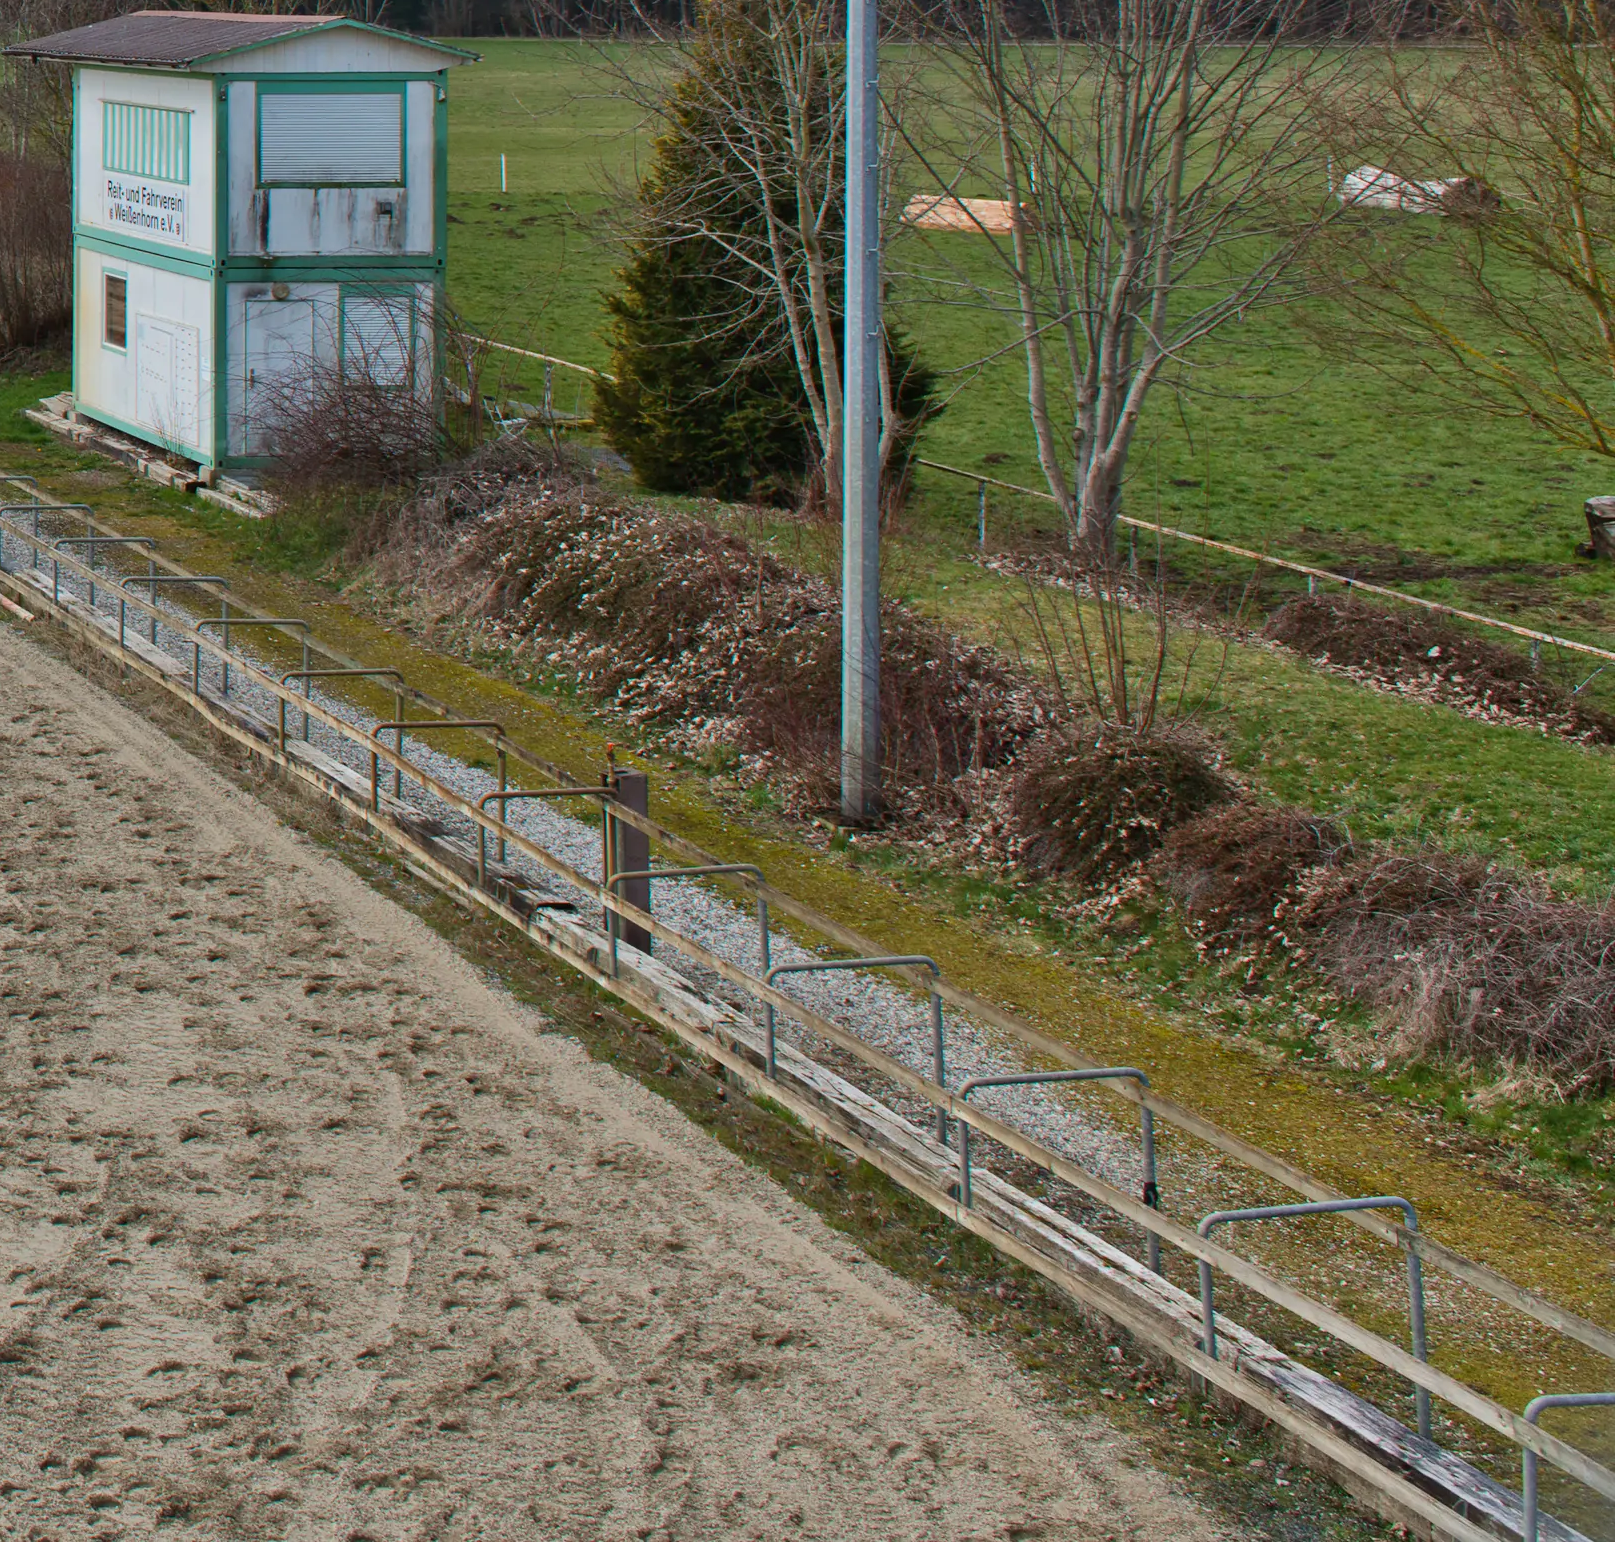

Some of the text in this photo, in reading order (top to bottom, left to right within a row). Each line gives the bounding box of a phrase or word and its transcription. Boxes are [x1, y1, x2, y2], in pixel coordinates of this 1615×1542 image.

[107, 179, 183, 212] Reit- und Fahrverein
[114, 202, 175, 233] Weißenhorn e.V.
